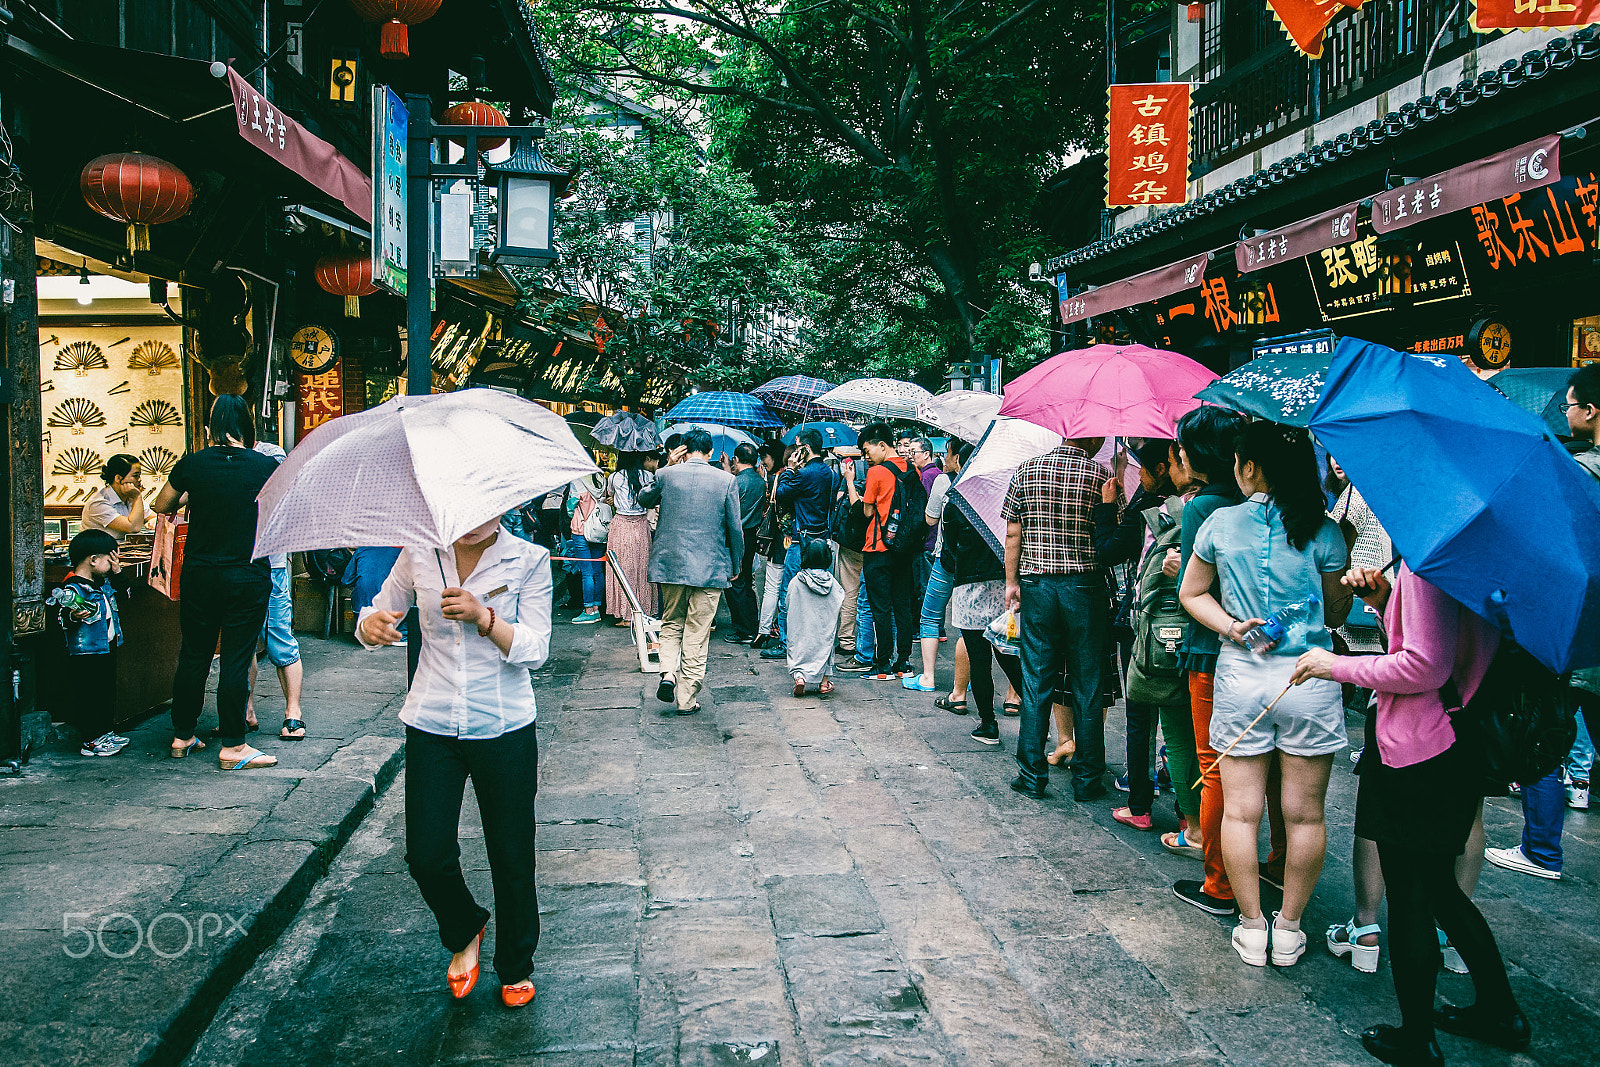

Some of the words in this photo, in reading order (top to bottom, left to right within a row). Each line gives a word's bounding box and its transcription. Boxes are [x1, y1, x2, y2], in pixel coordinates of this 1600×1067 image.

[251, 94, 288, 151] 王老吉
[1127, 94, 1171, 203] 古镇鸡杂
[1394, 183, 1443, 221] 王老吉
[1256, 234, 1289, 263] 王老吉
[1406, 334, 1464, 353] 一年卖出百万只
